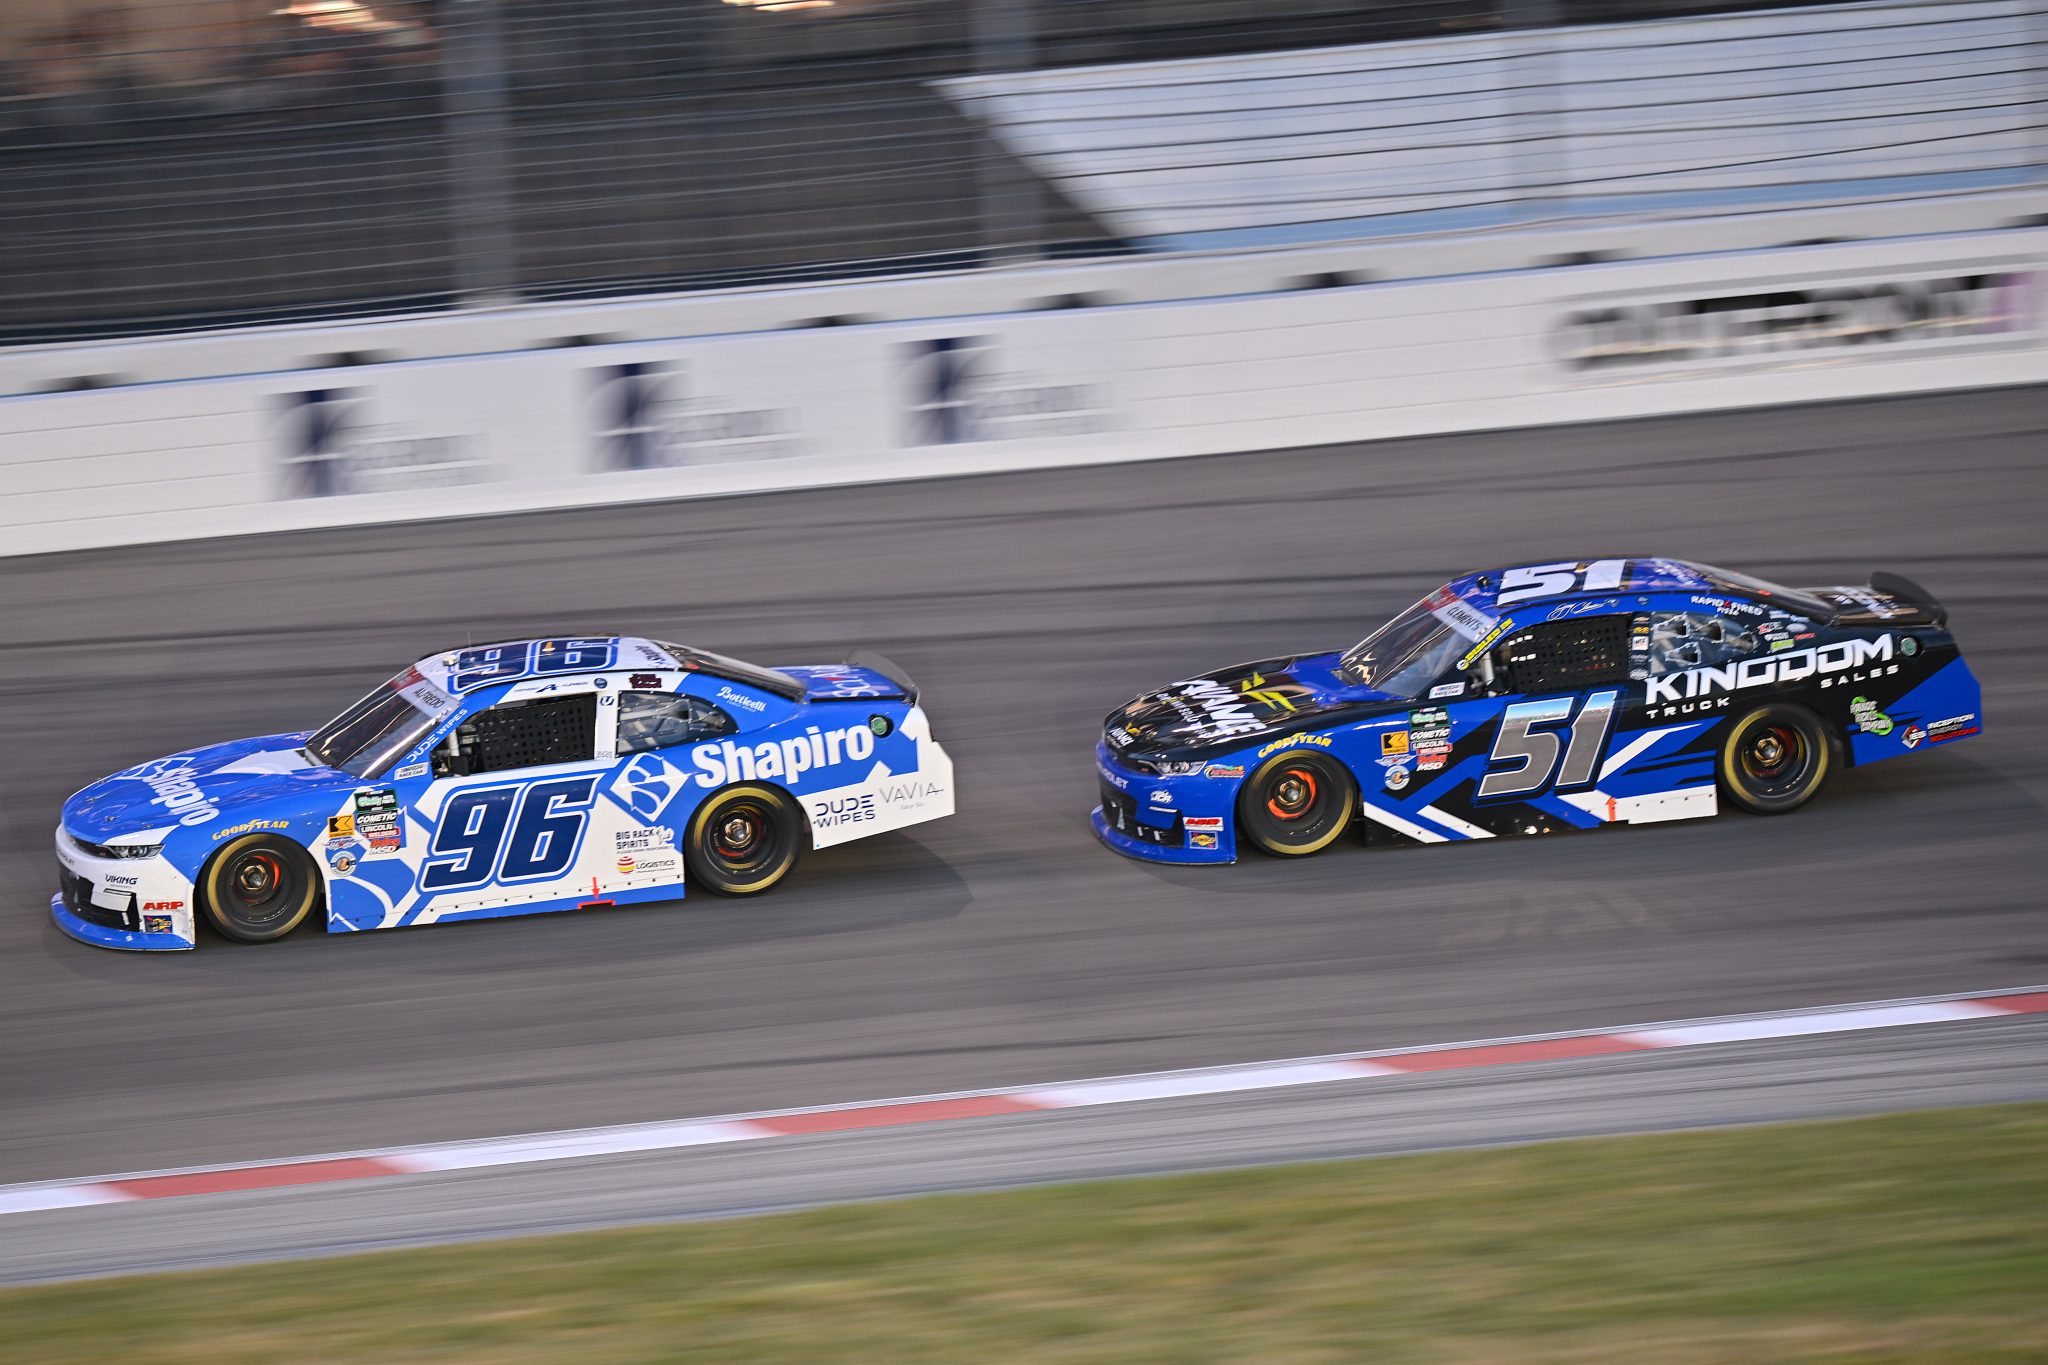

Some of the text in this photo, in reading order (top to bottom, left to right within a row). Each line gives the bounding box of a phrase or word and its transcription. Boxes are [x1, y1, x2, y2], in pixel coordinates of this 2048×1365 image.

[1498, 559, 1627, 606] 51
[1447, 606, 1483, 632] CLEMENTS
[1644, 633, 1894, 705] KINGDOM
[414, 687, 447, 709] ALFREDO
[716, 686, 767, 712] Botticelli
[1646, 664, 1899, 720] TRUCK SALES
[406, 708, 468, 763] DUDE WIPES
[1410, 727, 1451, 740] COMETIC
[1479, 689, 1618, 796] 51
[691, 725, 875, 788] Shapiro
[1257, 732, 1333, 759] GOODYEAR
[142, 767, 221, 827] Shapiro
[816, 794, 875, 817] DUDE
[357, 812, 397, 824] COMETIC
[361, 823, 393, 834] LINCOLN
[816, 809, 876, 829] WIPES
[212, 819, 290, 841] GOODYEAR
[423, 774, 603, 892] 96
[616, 828, 655, 841] BIG RACK
[616, 839, 649, 850] SPIRITS
[636, 859, 676, 870] LOGISTICS
[105, 873, 138, 885] VIKING
[143, 901, 184, 911] ARP
